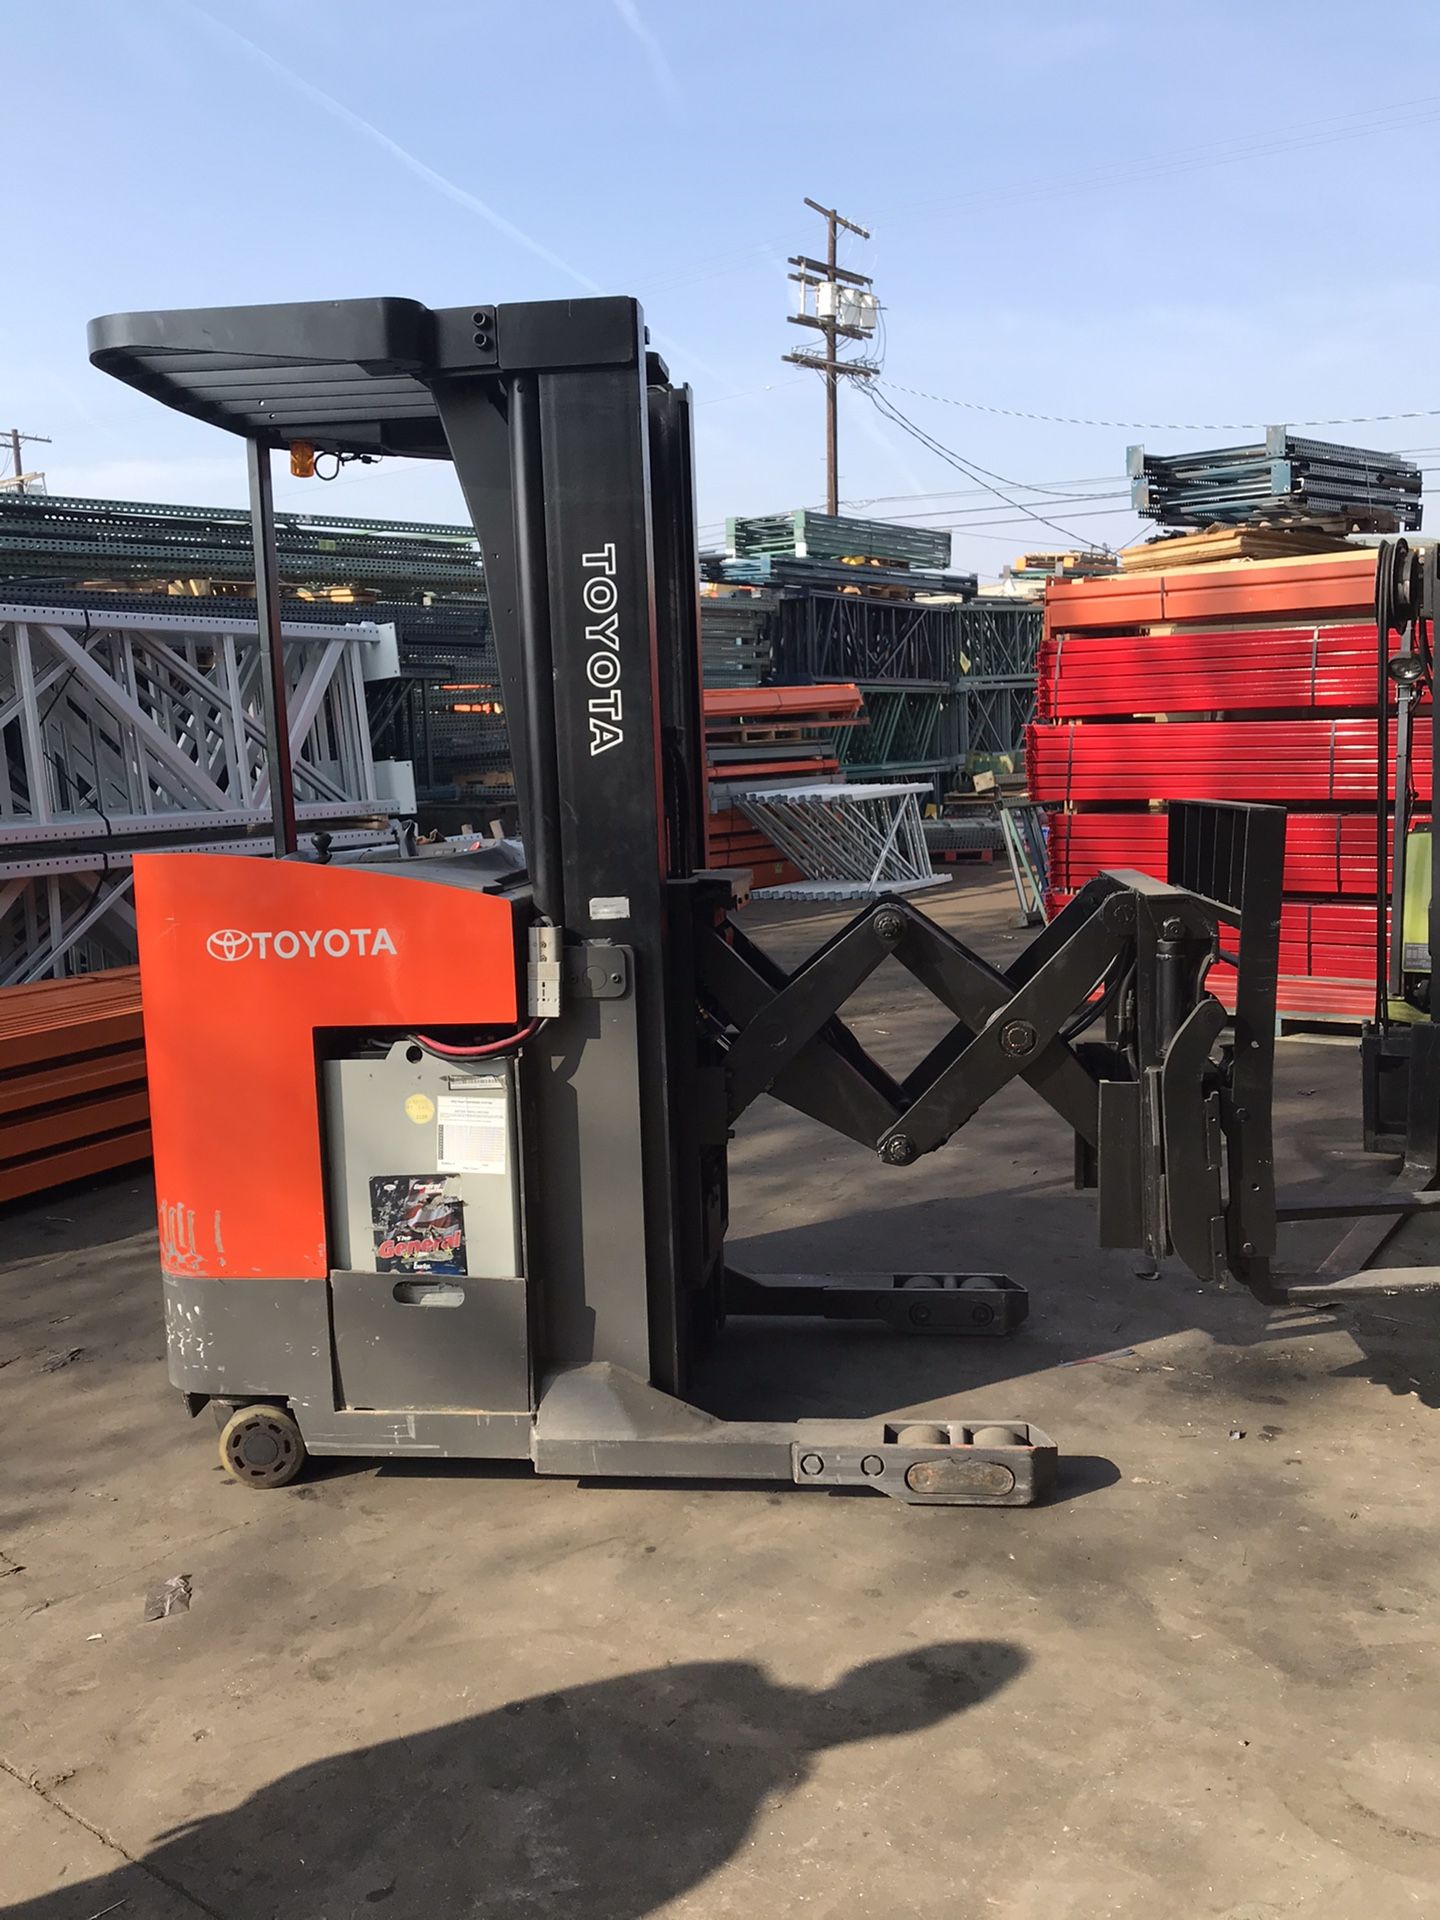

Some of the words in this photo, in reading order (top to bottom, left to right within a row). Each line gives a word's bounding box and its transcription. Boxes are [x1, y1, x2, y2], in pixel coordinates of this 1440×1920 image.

[582, 543, 624, 757] TOYOTA
[251, 928, 398, 960] TOYOTA
[377, 1229, 462, 1259] General
